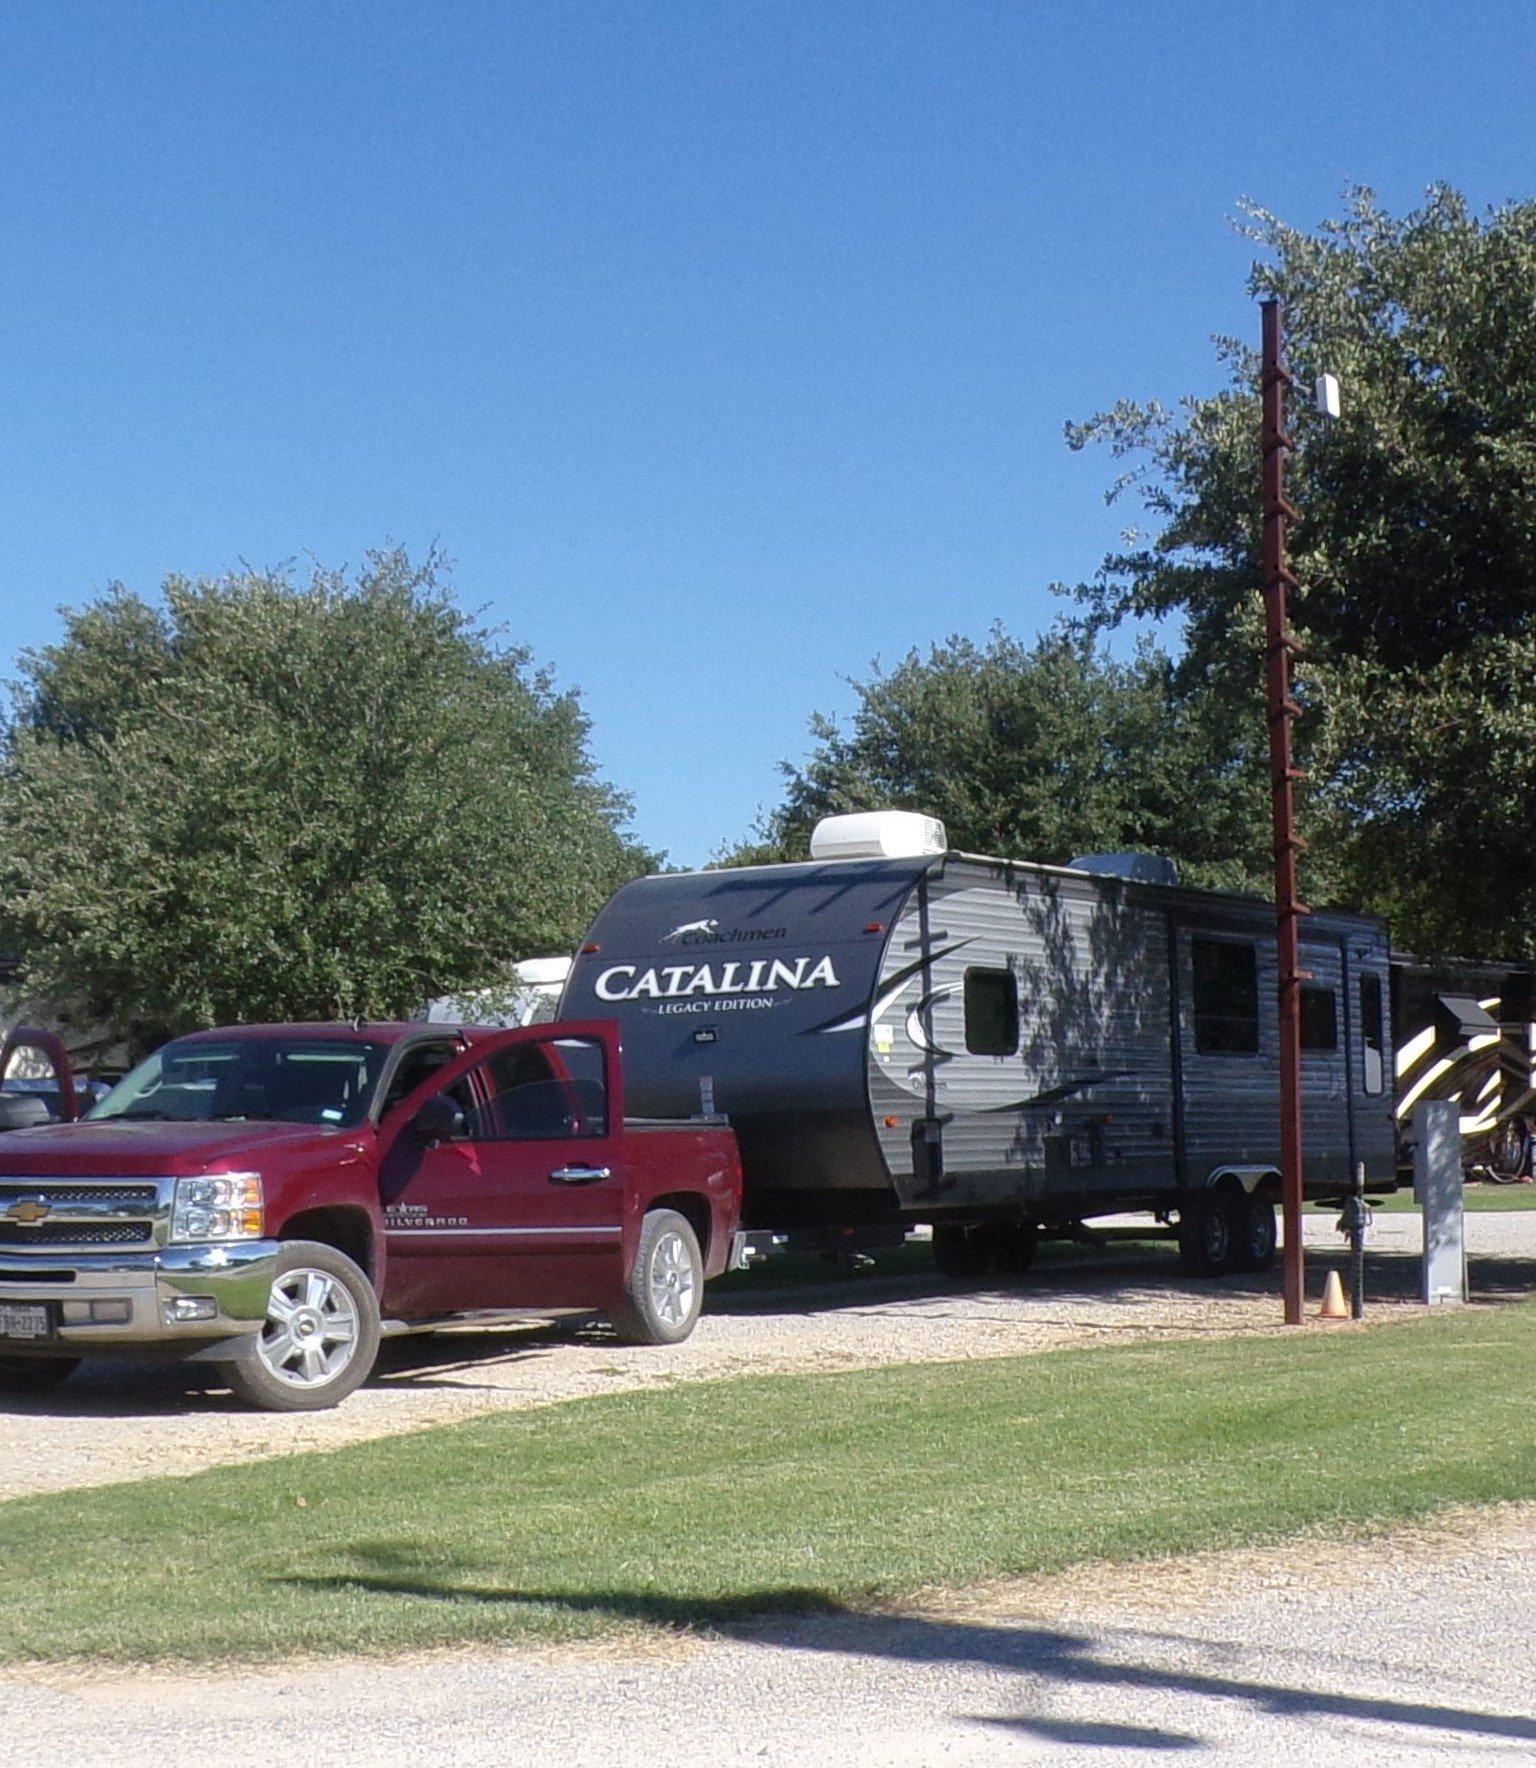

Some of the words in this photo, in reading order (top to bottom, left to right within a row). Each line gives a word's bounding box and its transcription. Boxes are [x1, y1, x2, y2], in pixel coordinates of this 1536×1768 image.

[681, 927, 787, 945] Coachmen
[594, 955, 841, 1001] CATALINA
[657, 1001, 712, 1015] LEGACY
[714, 997, 774, 1012] EDITION
